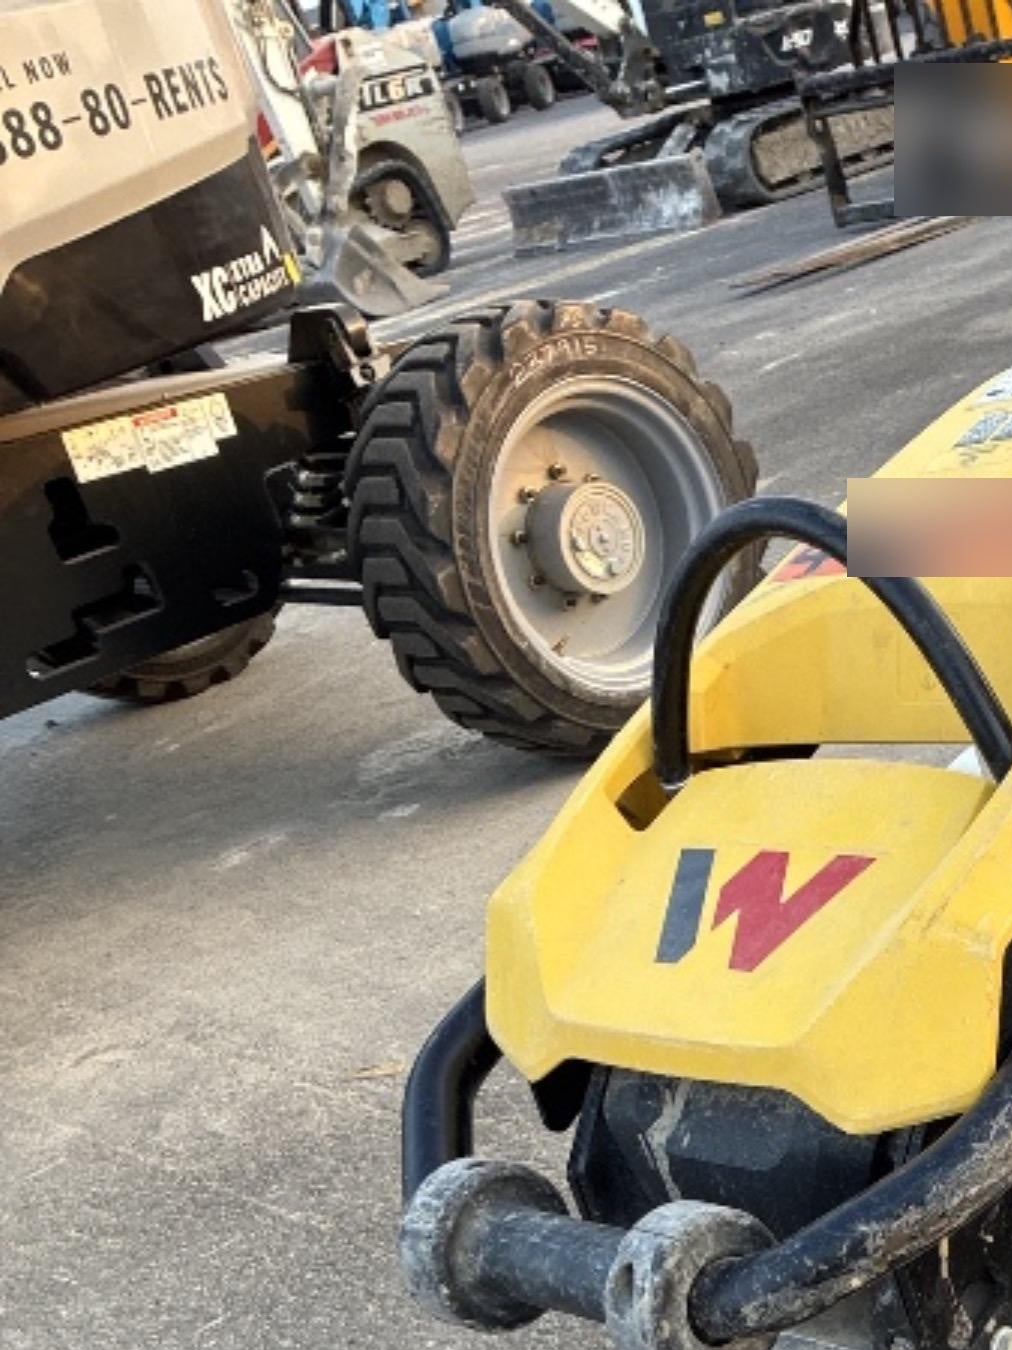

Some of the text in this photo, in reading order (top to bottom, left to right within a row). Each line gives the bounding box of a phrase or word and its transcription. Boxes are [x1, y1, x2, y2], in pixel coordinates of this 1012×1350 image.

[0, 51, 71, 91] L NOW
[191, 266, 238, 322] XC
